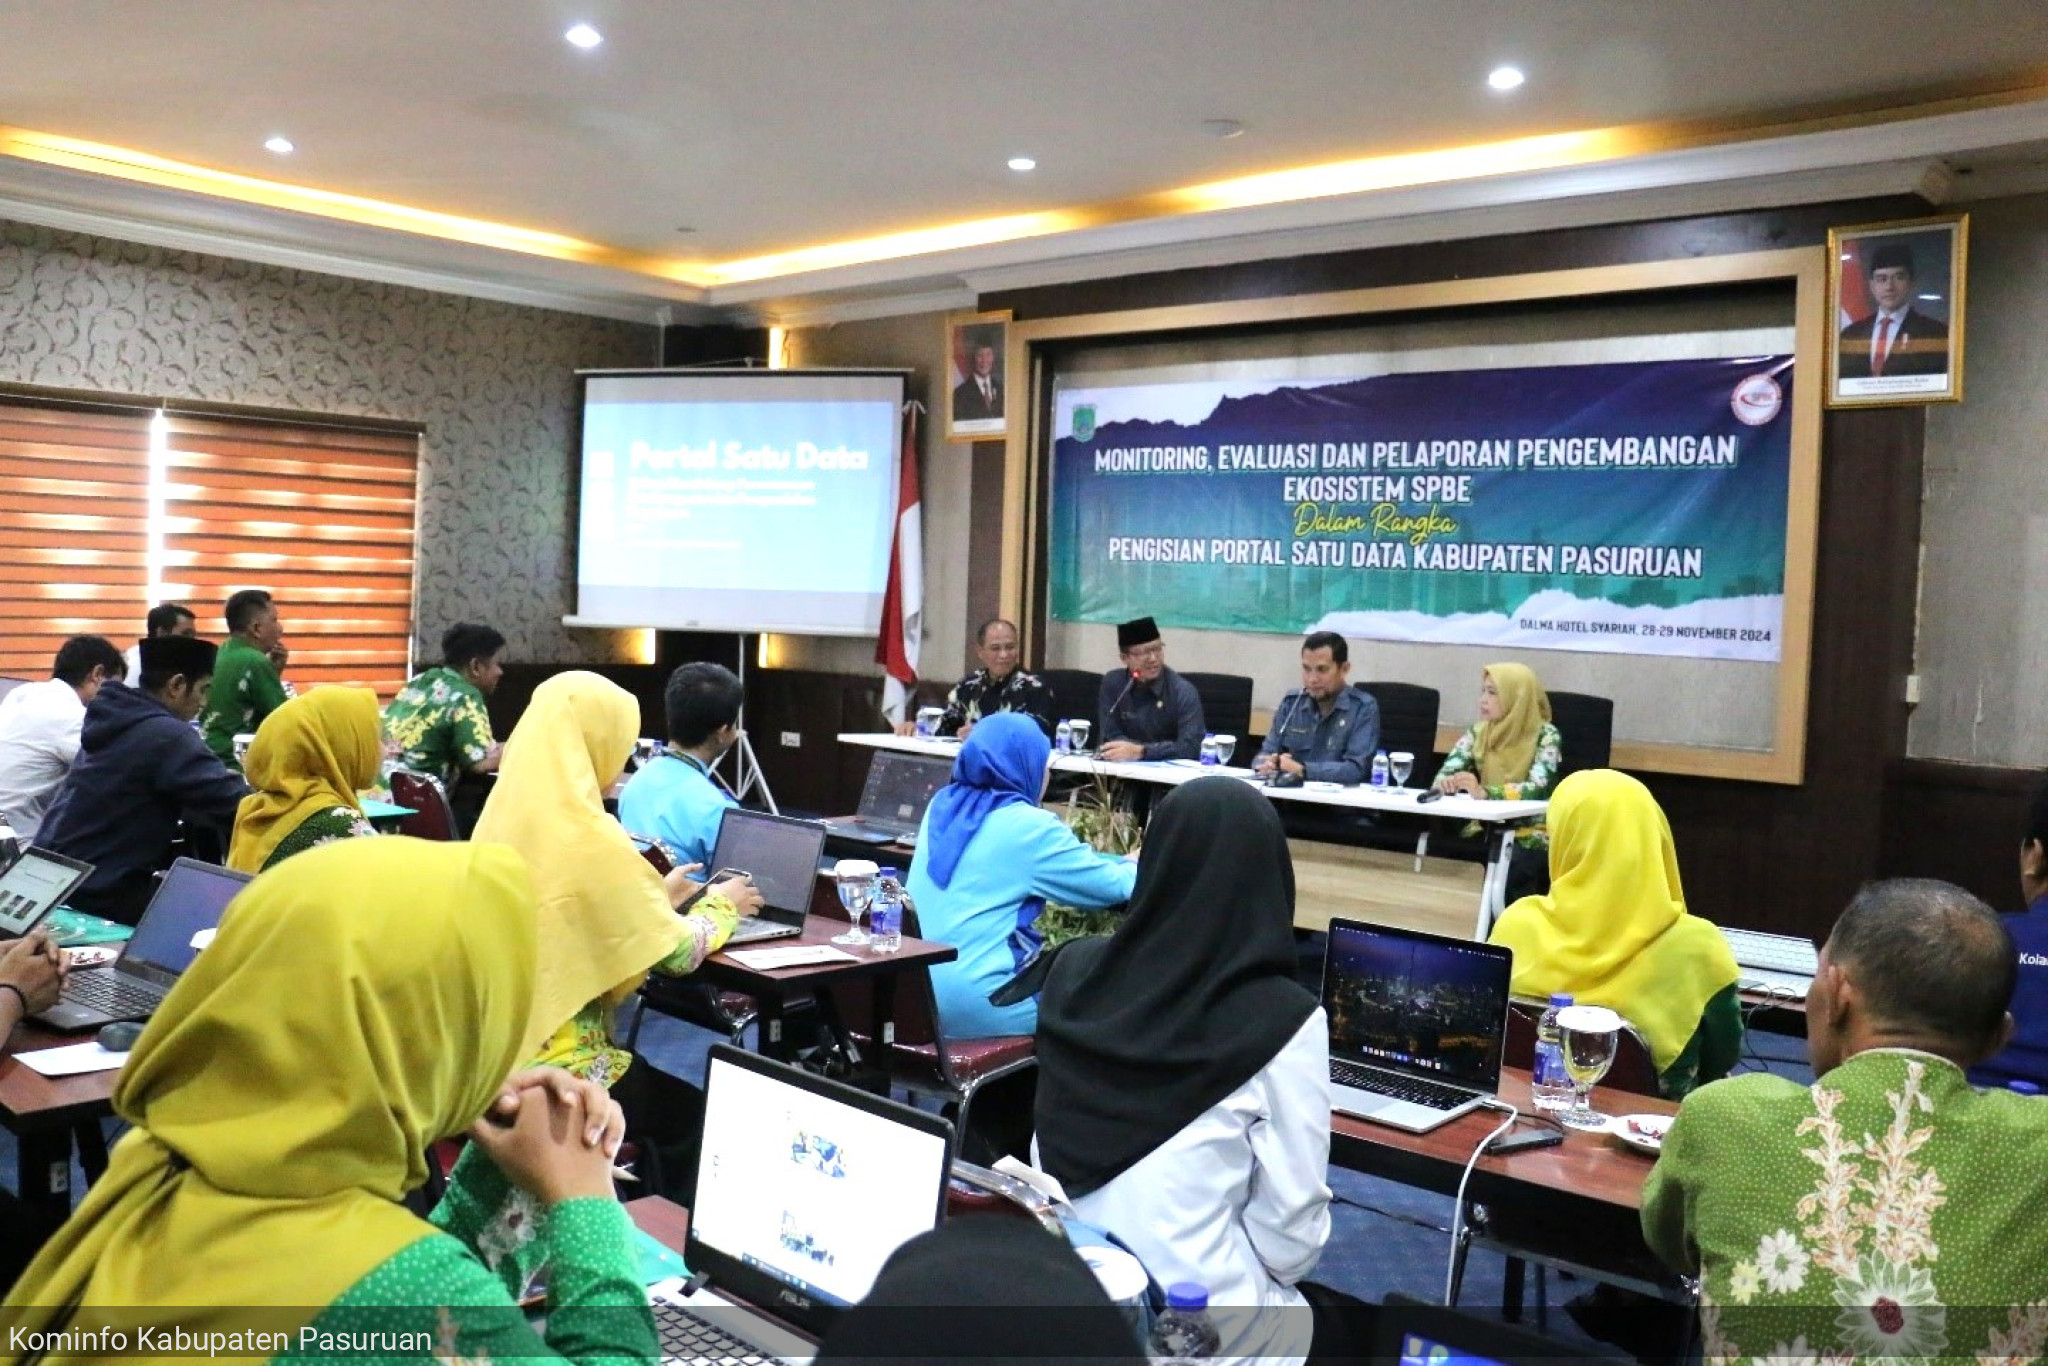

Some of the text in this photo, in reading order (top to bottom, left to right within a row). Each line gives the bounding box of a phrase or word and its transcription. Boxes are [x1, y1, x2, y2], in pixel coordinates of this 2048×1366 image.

[629, 440, 869, 471] Portal Satu Data
[1095, 435, 1736, 473] MONITORING, EVALUASI DAN PELAPORAN PENGEMBANGAN
[1283, 475, 1471, 503] EKOSISTEM SPBE
[1294, 501, 1458, 546] Dalam Rangka
[1108, 537, 1703, 578] PENGISIAN PORTAL SATU DATA KABUPATEN PASURUAN
[1556, 620, 1590, 634] HOTEL
[1642, 624, 1674, 637] 28-29
[1676, 626, 1737, 640] NOVEMBER
[1740, 629, 1772, 642] 2024
